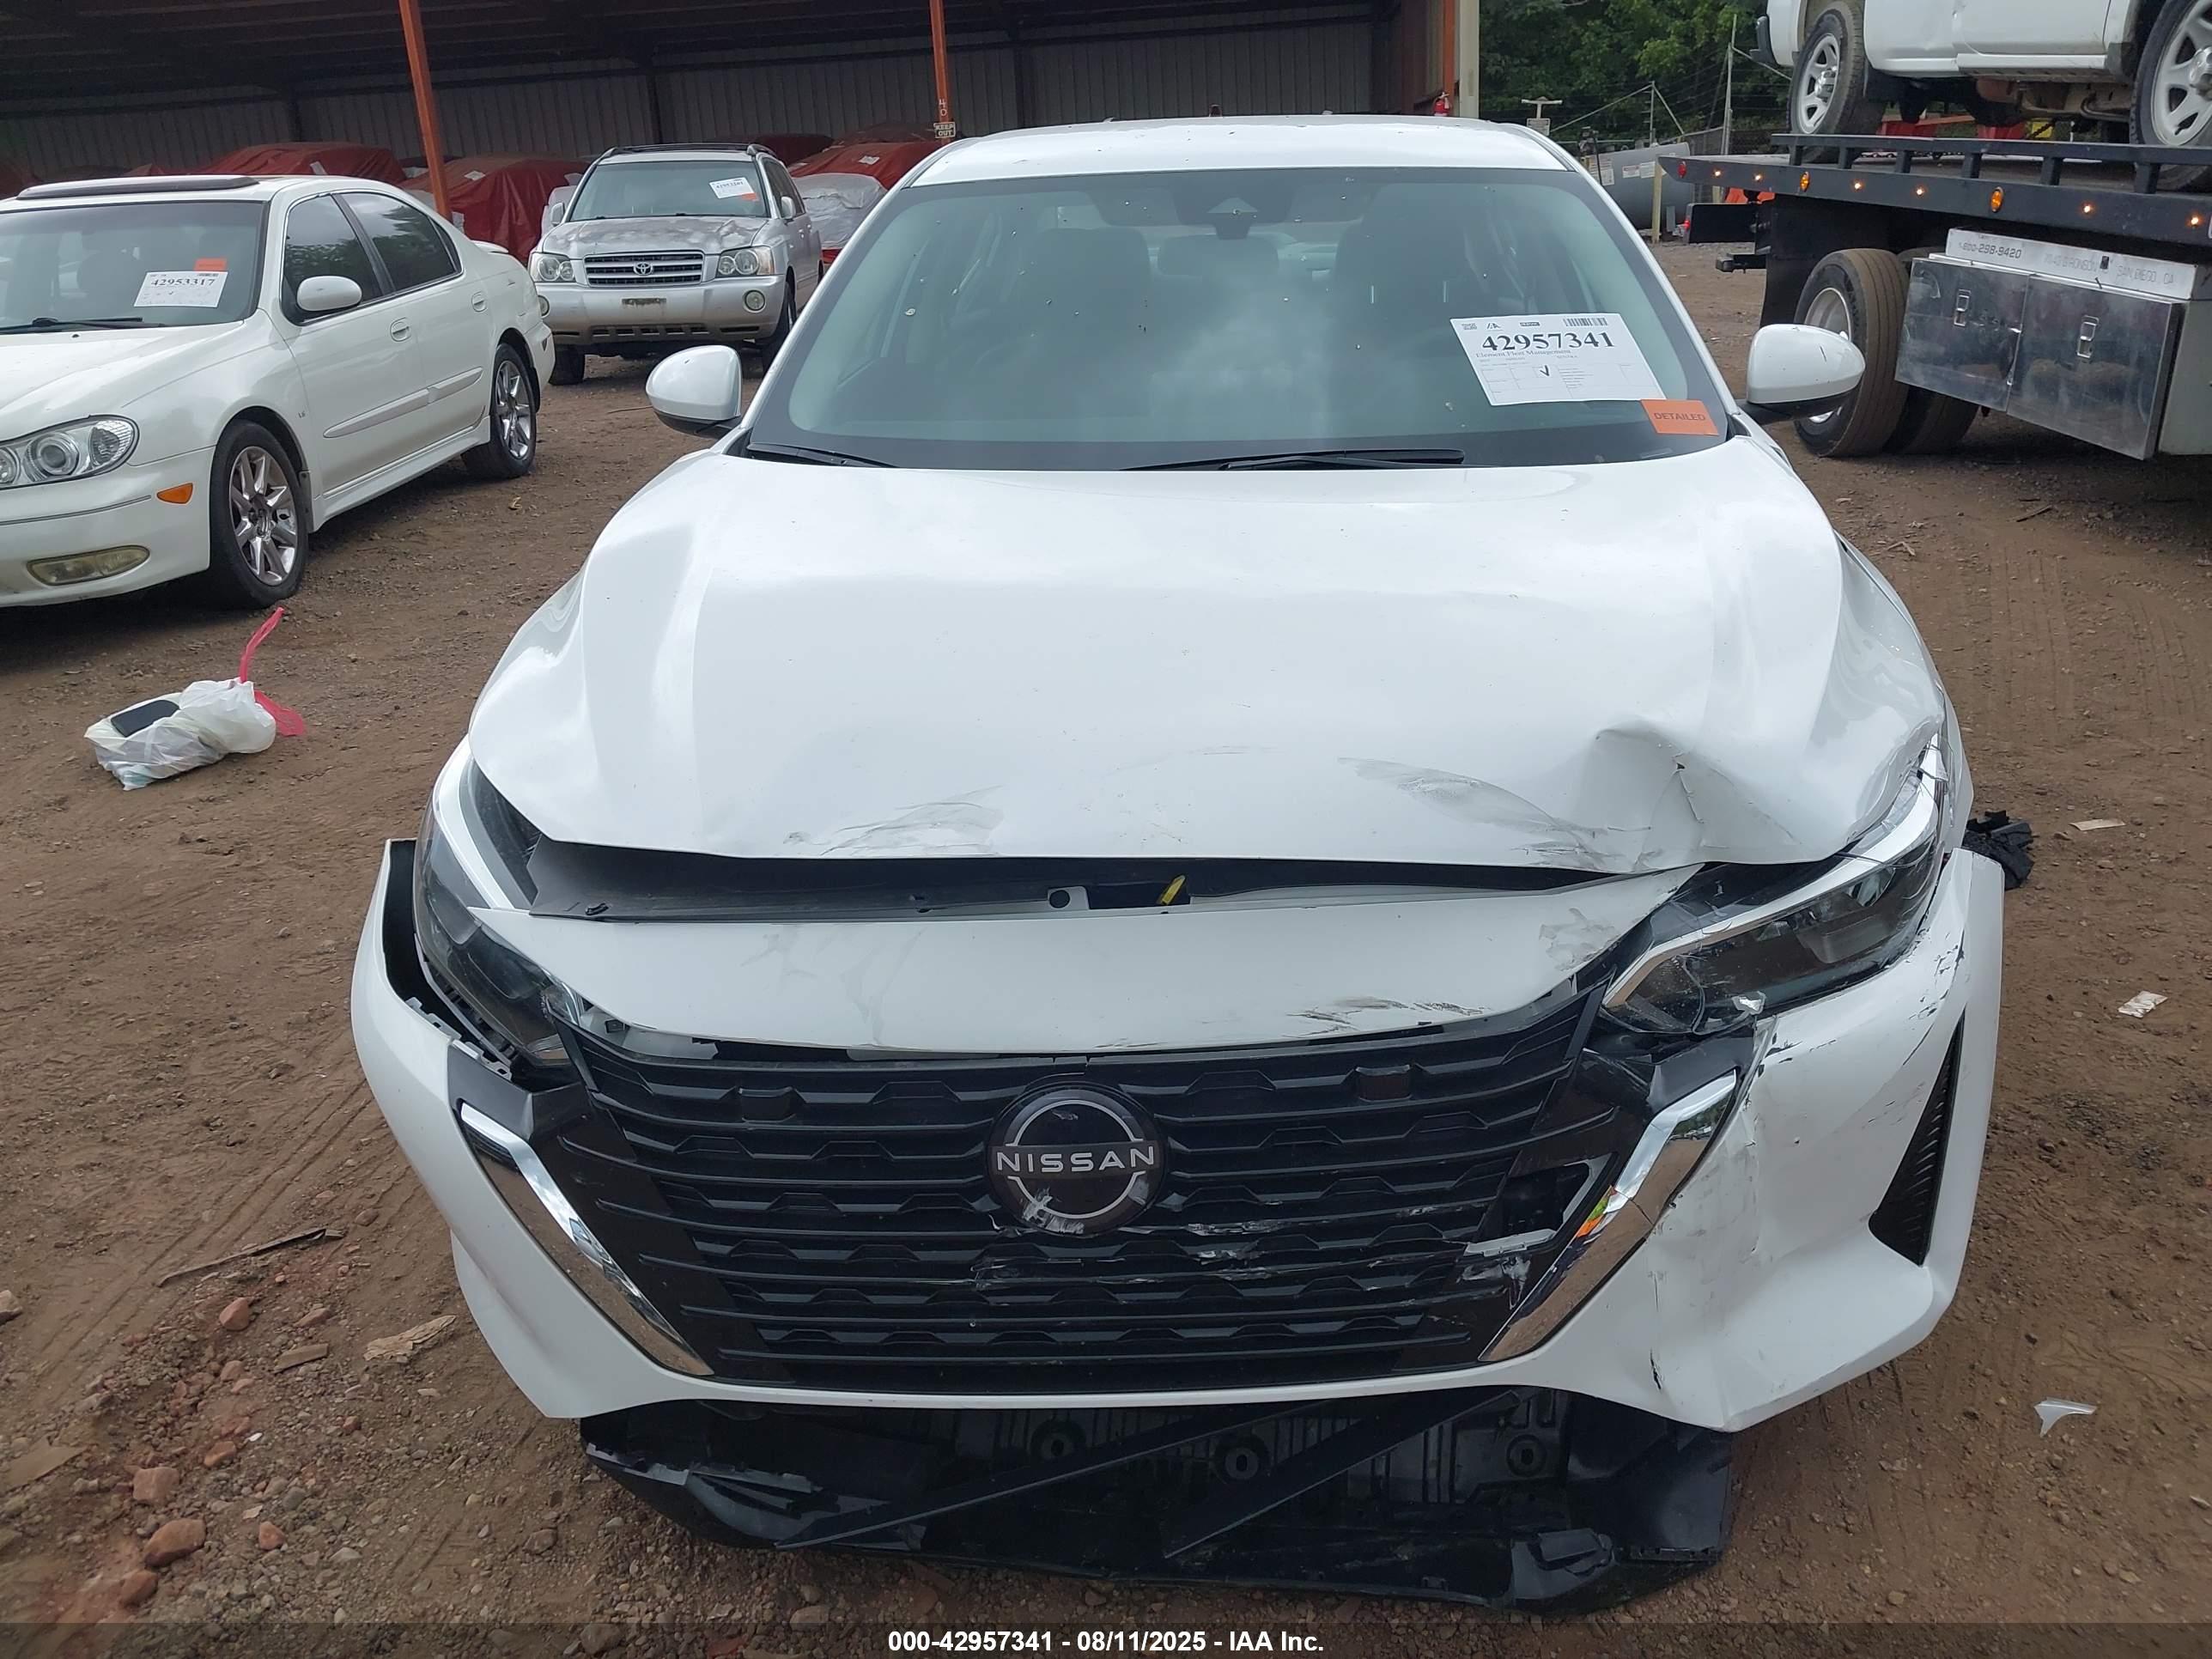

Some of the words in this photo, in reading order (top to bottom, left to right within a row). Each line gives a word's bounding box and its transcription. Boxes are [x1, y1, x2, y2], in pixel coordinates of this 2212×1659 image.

[1482, 331, 1615, 351] 42957341
[1654, 412, 1706, 422] DETAILED
[996, 1146, 1155, 1173] NISSAN
